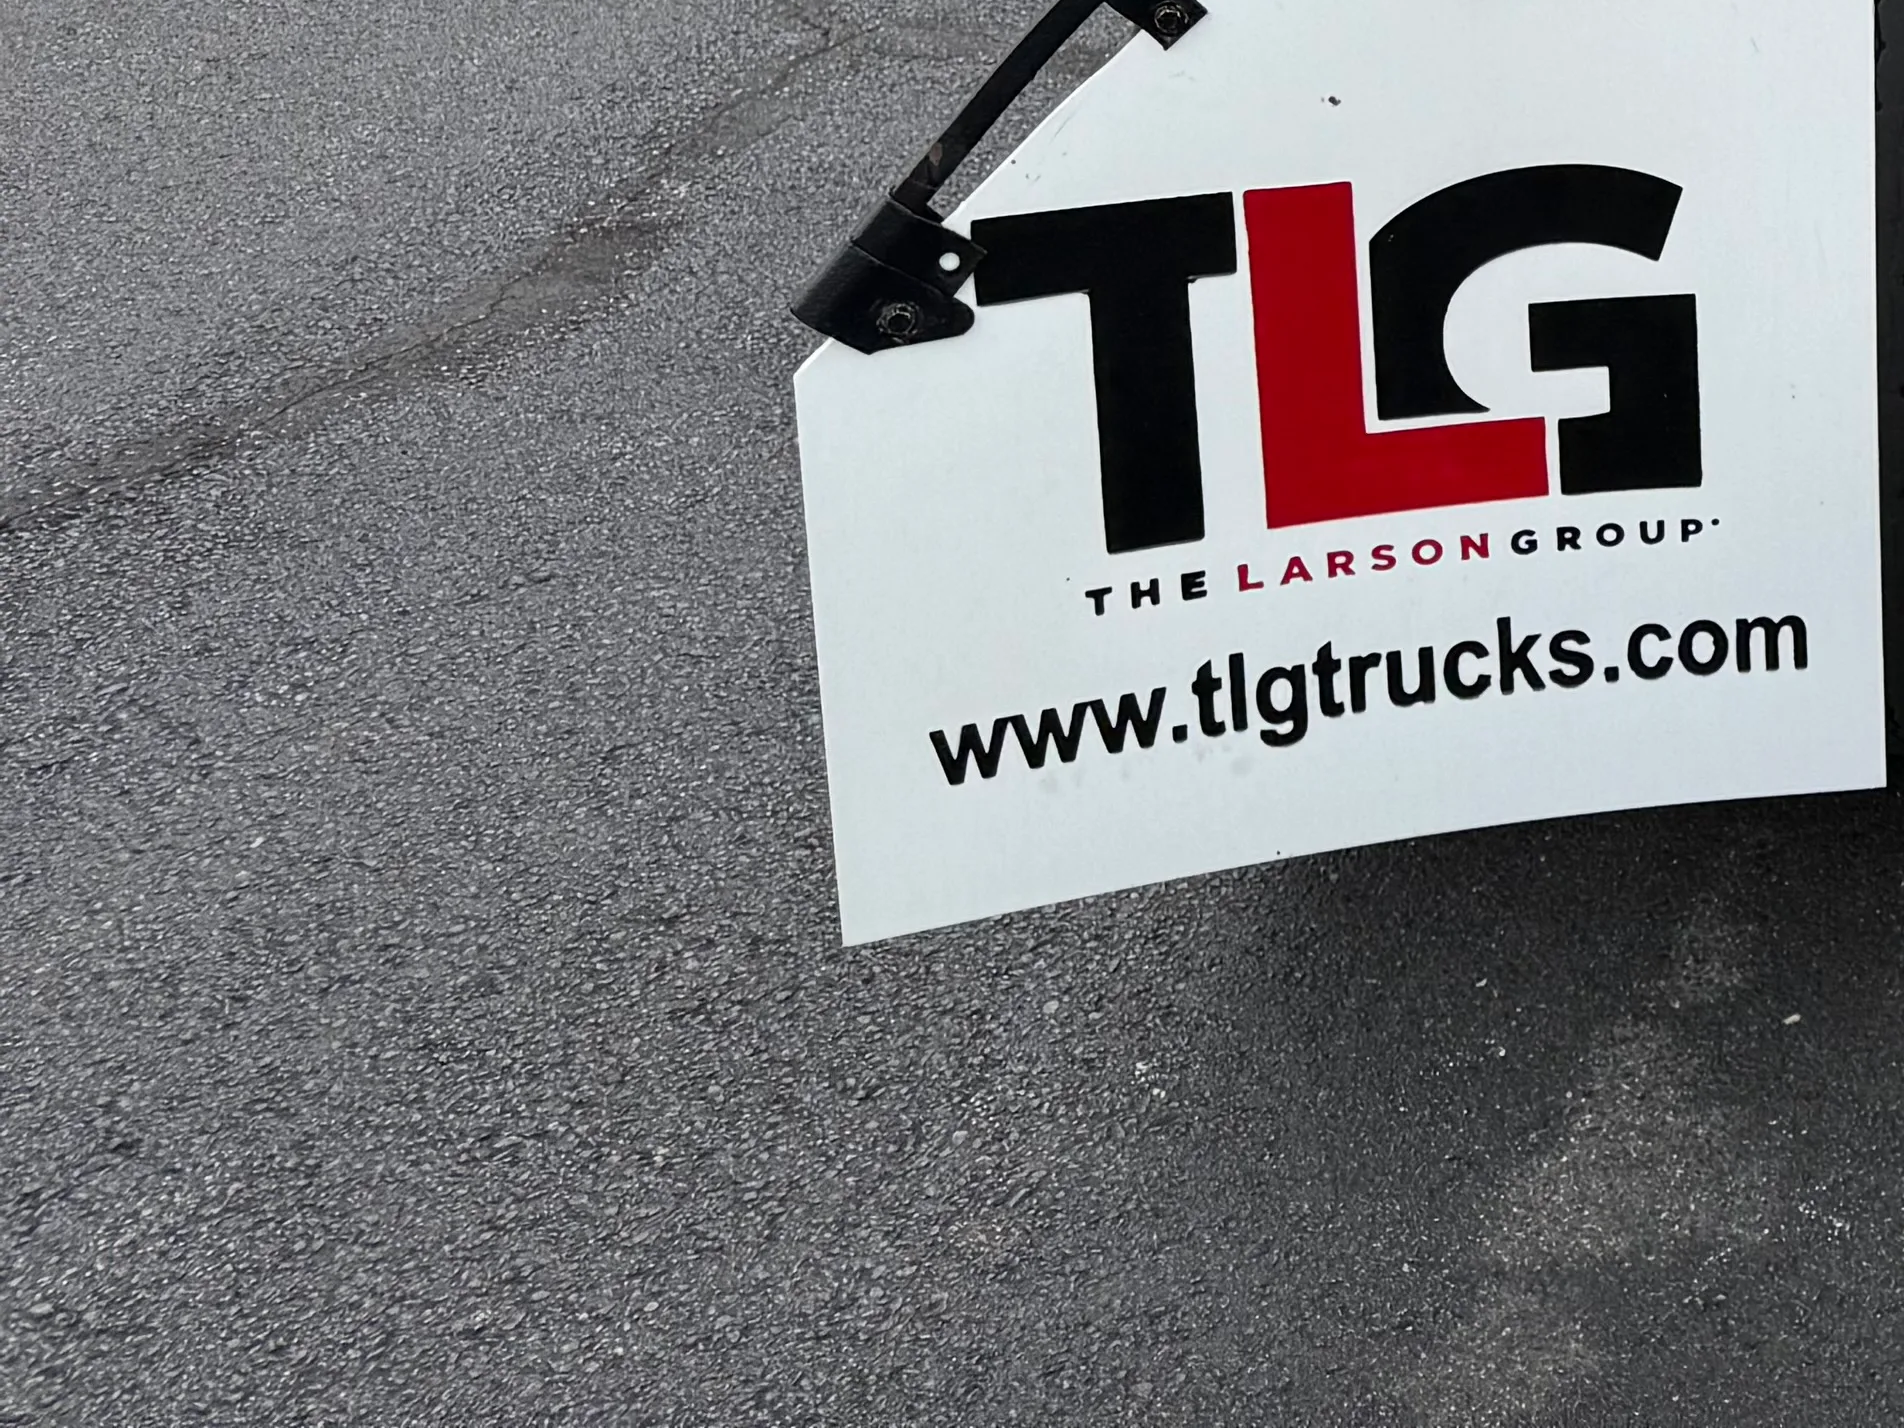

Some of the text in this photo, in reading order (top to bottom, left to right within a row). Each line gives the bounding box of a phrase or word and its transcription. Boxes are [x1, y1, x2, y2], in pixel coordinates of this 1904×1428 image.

[969, 163, 1703, 554] TLG
[1085, 518, 1704, 616] THE LARSON GROUP
[928, 614, 1809, 786] www.tlgtrucks.com
